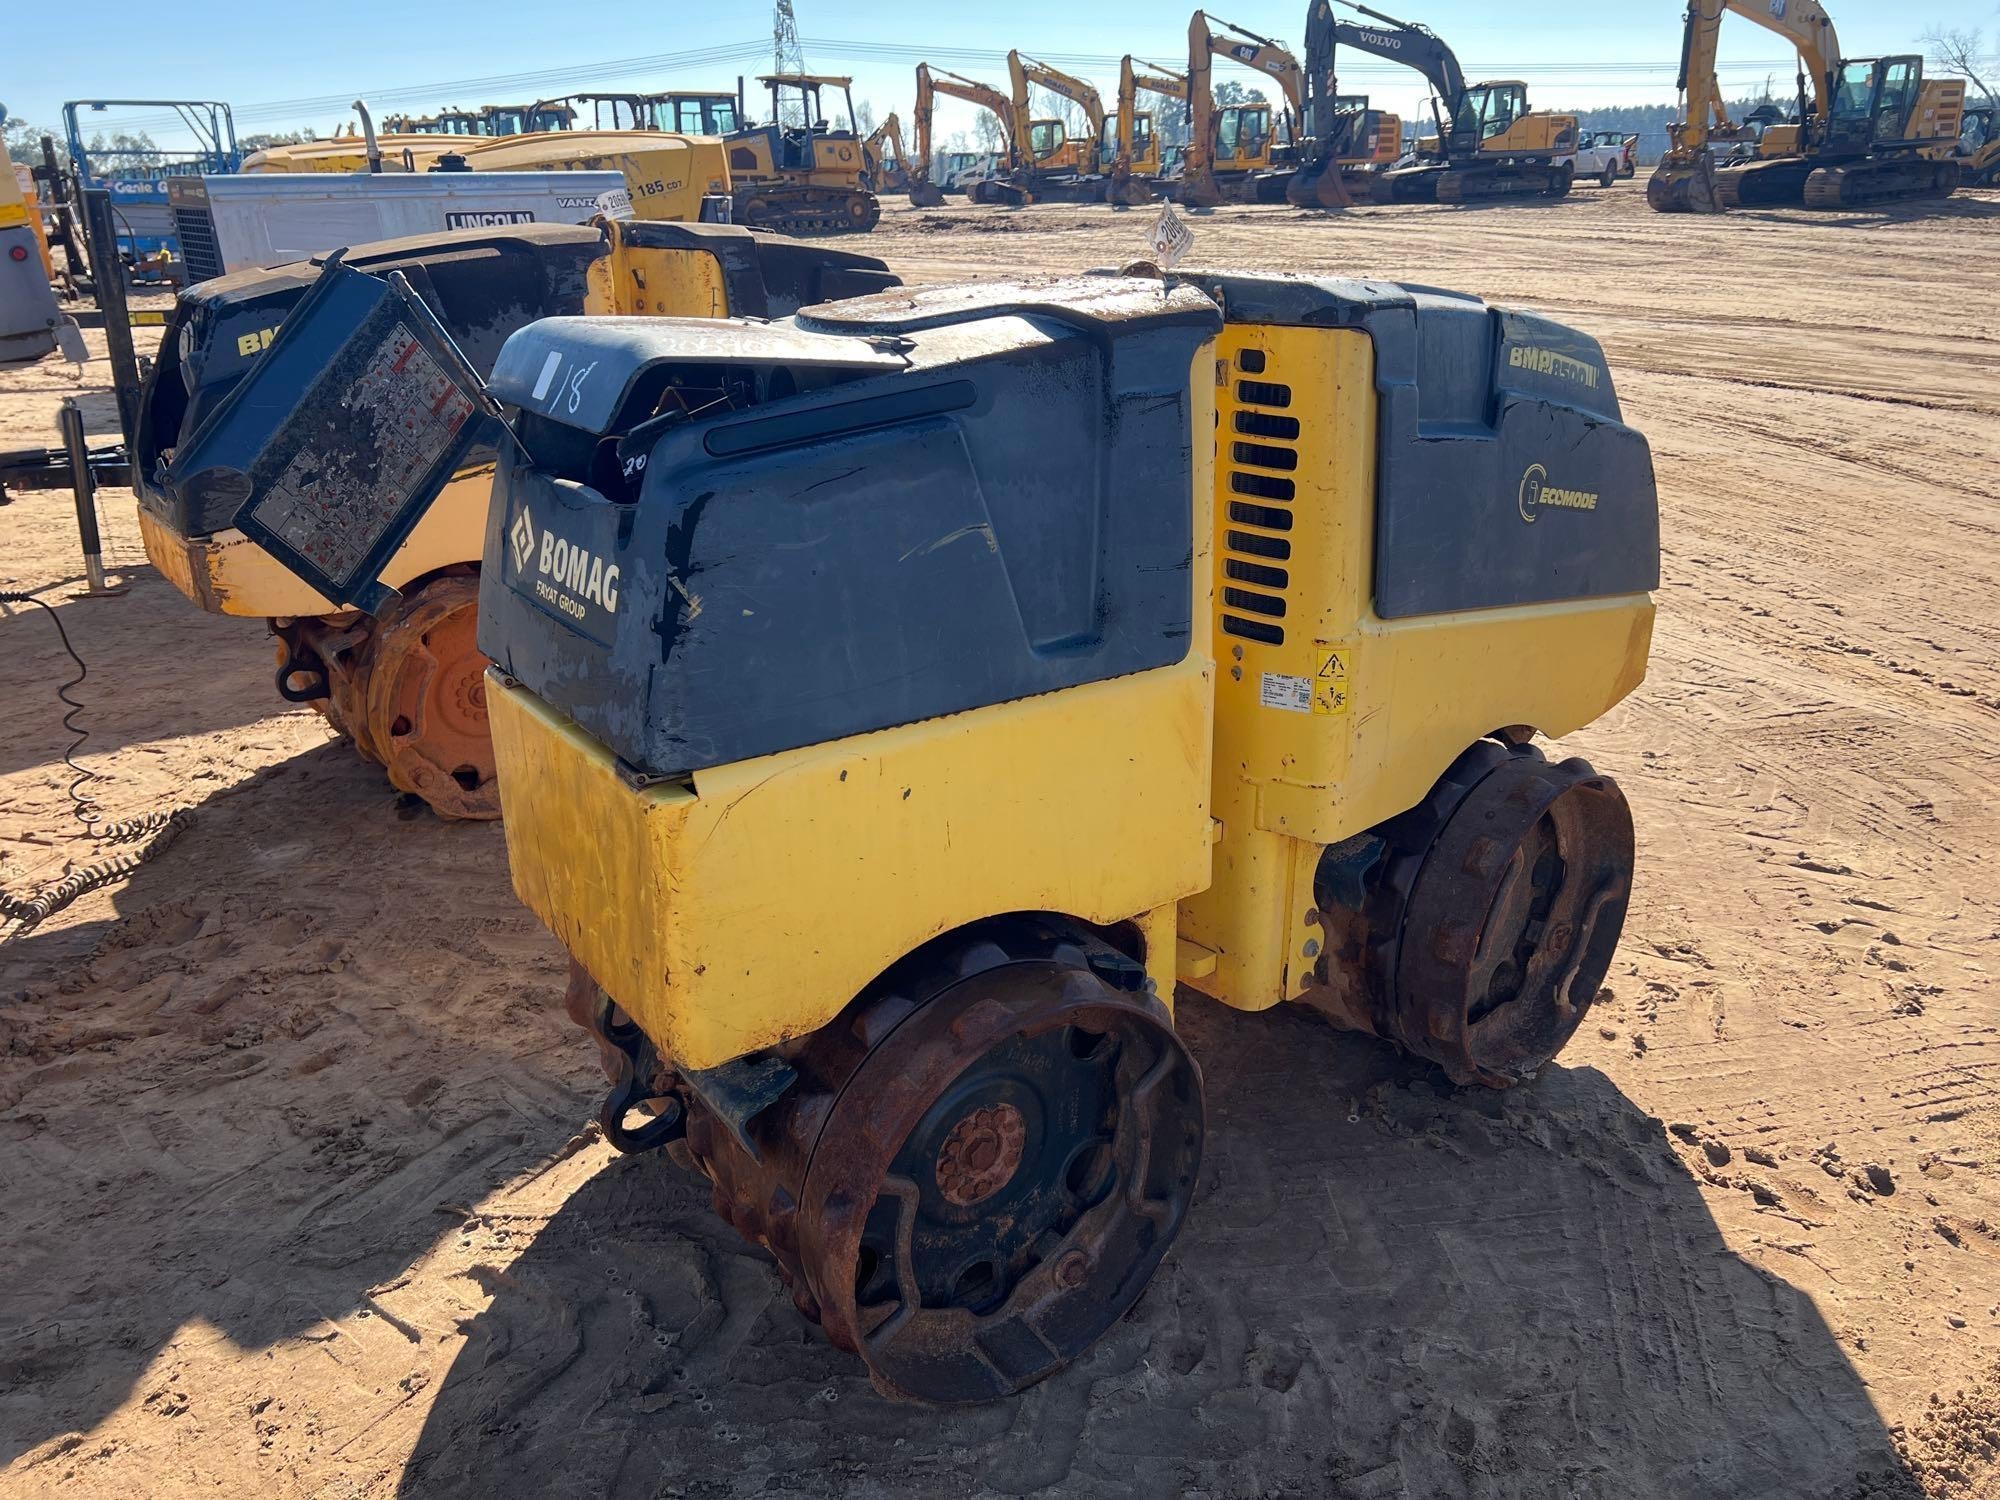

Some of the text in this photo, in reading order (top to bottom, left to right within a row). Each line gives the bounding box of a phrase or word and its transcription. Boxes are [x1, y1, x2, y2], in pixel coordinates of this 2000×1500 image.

[1359, 31, 1401, 49] VOLVO
[1240, 46, 1253, 60] CAT
[1044, 76, 1073, 95] KOMATSU
[1151, 80, 1181, 93] KOMATSU
[114, 181, 152, 194] Genie
[638, 180, 665, 197] 185
[1538, 487, 1599, 510] ECOMODE
[539, 529, 620, 613] BOMAG
[536, 580, 586, 620] FAYAT GROUP
